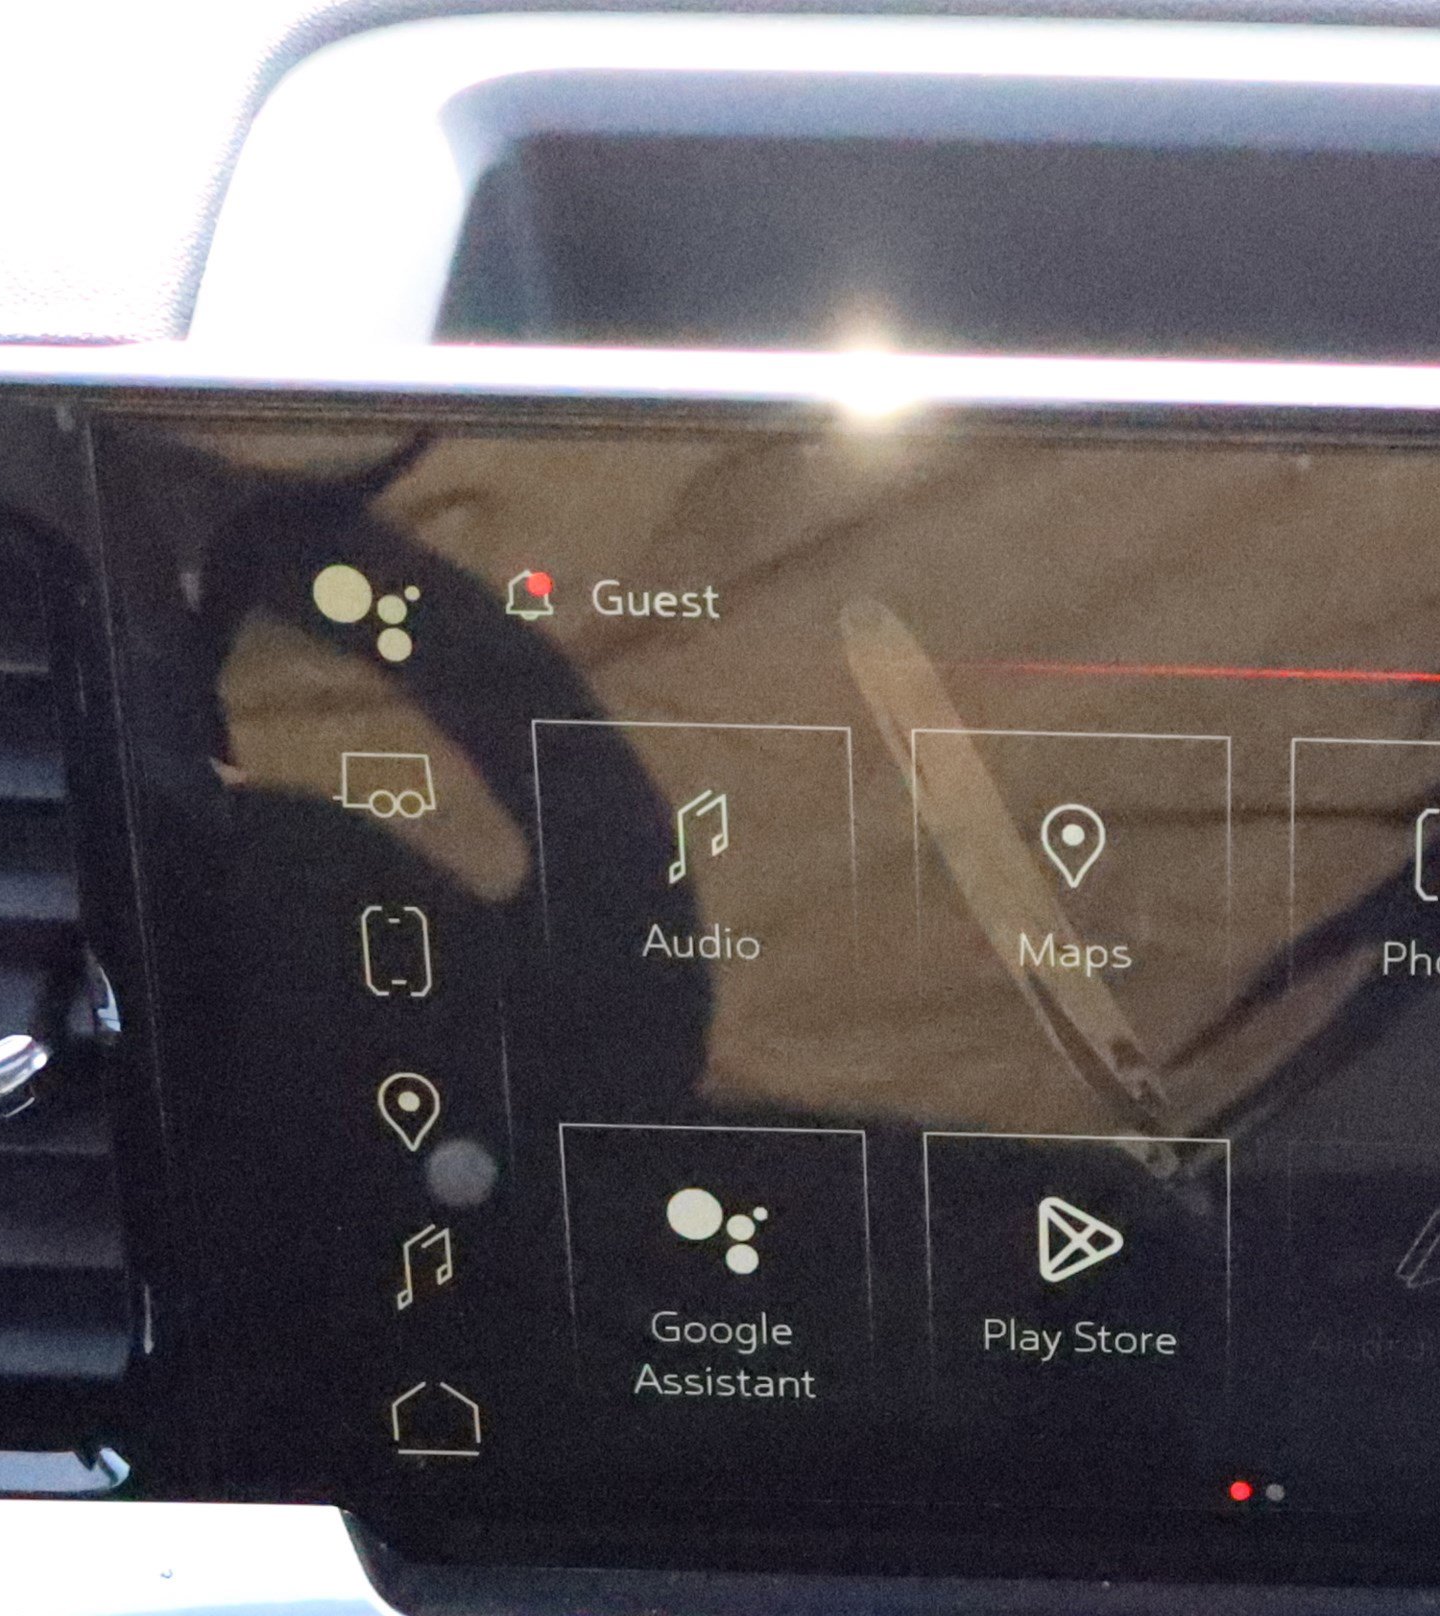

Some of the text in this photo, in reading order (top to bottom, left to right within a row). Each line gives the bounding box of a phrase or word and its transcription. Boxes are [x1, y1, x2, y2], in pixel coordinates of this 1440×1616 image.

[592, 579, 719, 618] Guest
[642, 923, 761, 961] Audio
[1019, 933, 1132, 974] Maps
[651, 1311, 792, 1355] Google
[984, 1318, 1177, 1362] Play Store
[634, 1364, 815, 1398] Assistant
